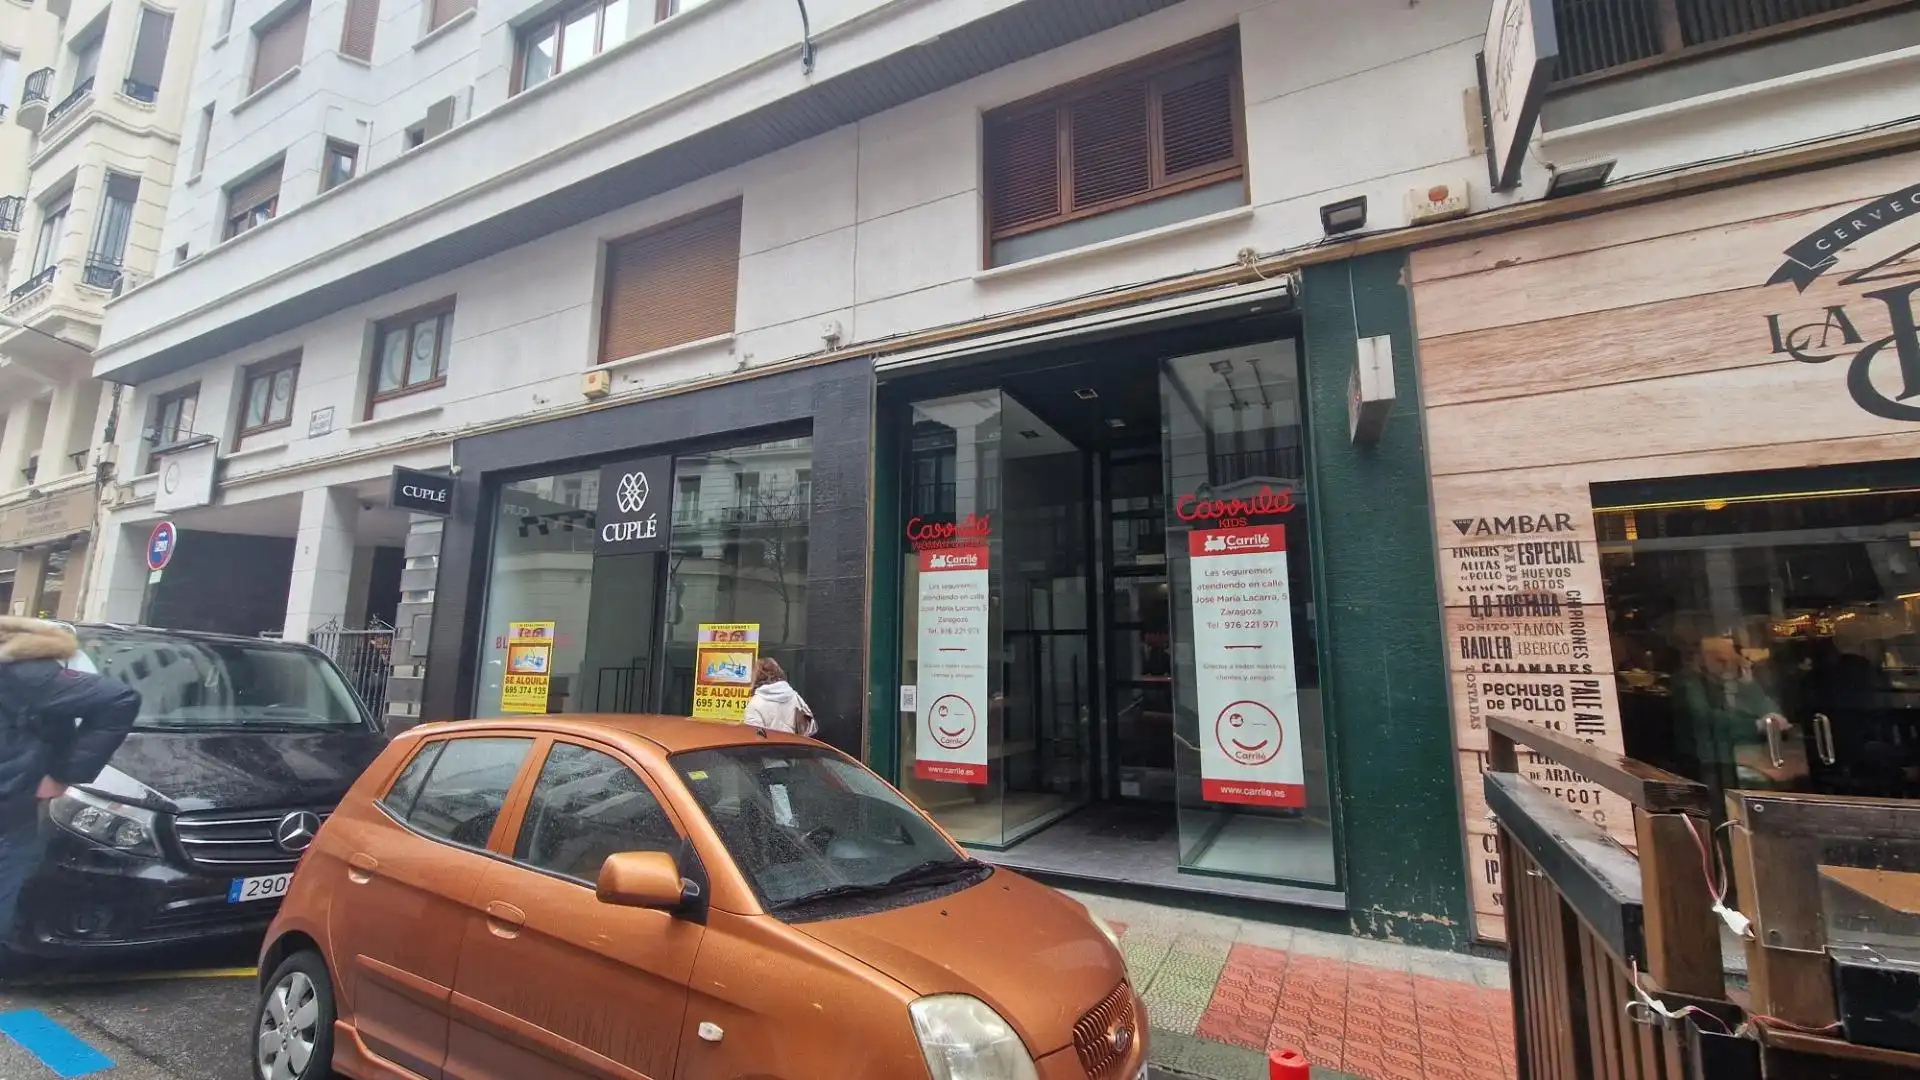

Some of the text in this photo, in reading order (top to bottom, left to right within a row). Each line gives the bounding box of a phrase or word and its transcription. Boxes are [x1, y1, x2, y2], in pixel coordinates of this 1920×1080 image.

[402, 484, 447, 503] CUPLÉ
[602, 513, 657, 542] CUPLÉ
[1218, 517, 1248, 528] KIDS
[1475, 512, 1576, 536] AMBAR
[1452, 546, 1500, 558] FINGERS
[1517, 540, 1585, 566] ESPECIAL
[1460, 560, 1500, 571] ALITAS
[1469, 571, 1502, 580] POLLO
[1520, 568, 1572, 578] HUEVOS
[1197, 581, 1246, 591] atendiendo
[1262, 580, 1284, 588] calle
[1523, 579, 1565, 591] ROTOS
[1496, 593, 1562, 618] TOSTADA
[1220, 608, 1262, 617] Zaragoza
[1224, 621, 1242, 629] 976
[1244, 620, 1260, 629] 221
[1263, 620, 1279, 628] 971
[1456, 622, 1510, 632] BONITO
[1460, 635, 1513, 660] RADLER
[1482, 662, 1593, 675] CALAMARES
[505, 676, 547, 686] SE ALQUILA
[533, 686, 546, 695] 135
[696, 687, 708, 696] SE
[1569, 680, 1603, 710] PALE
[1466, 664, 1482, 730] TOSTADAS
[696, 698, 750, 710] 695 374 13
[1512, 698, 1566, 712] POLLO
[1530, 768, 1596, 784] DE ARAG
[246, 876, 288, 897] 290
